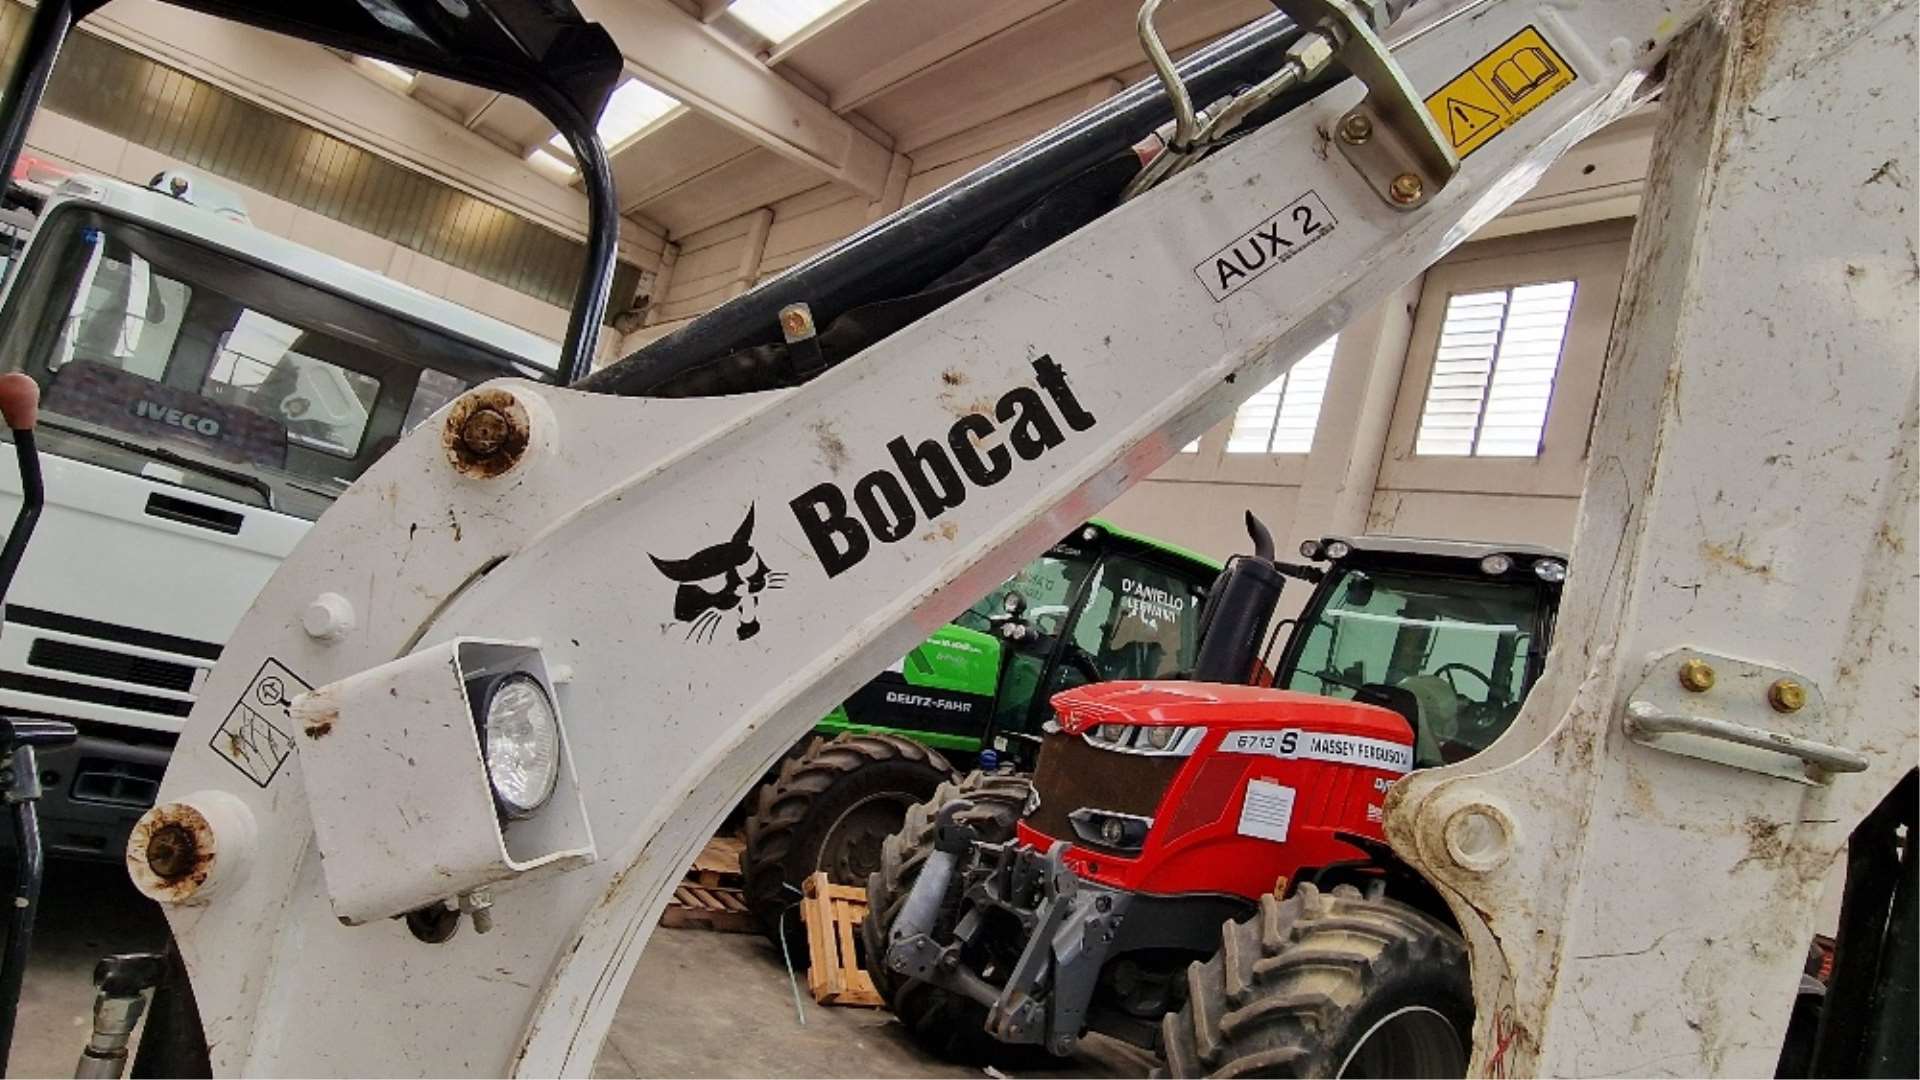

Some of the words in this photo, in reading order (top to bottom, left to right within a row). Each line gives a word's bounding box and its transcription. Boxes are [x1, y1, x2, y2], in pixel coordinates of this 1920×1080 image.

[1216, 221, 1294, 290] AUX
[1293, 206, 1322, 236] 2
[136, 400, 219, 436] IVECO
[789, 354, 1096, 579] Bobcat
[885, 691, 973, 713] DEUTZ-FAHR
[1237, 735, 1275, 749] 6713
[1279, 731, 1299, 754] S
[1310, 737, 1354, 757] MASSEY
